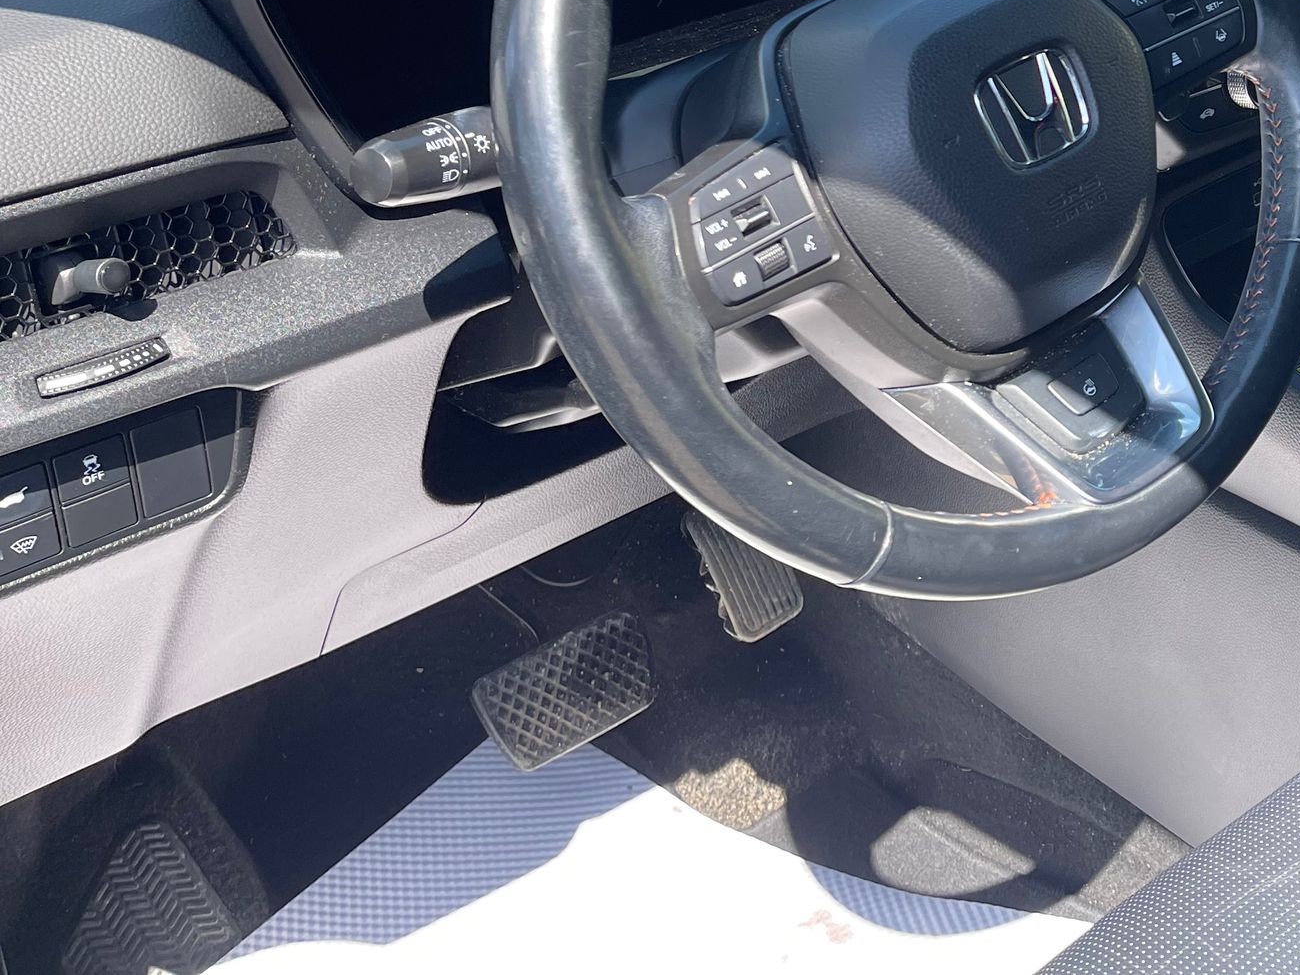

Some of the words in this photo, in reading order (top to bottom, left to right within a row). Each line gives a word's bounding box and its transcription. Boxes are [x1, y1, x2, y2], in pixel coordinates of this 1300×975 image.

[422, 126, 442, 137] OFF
[425, 137, 453, 152] AUTO
[82, 471, 105, 486] OFF
